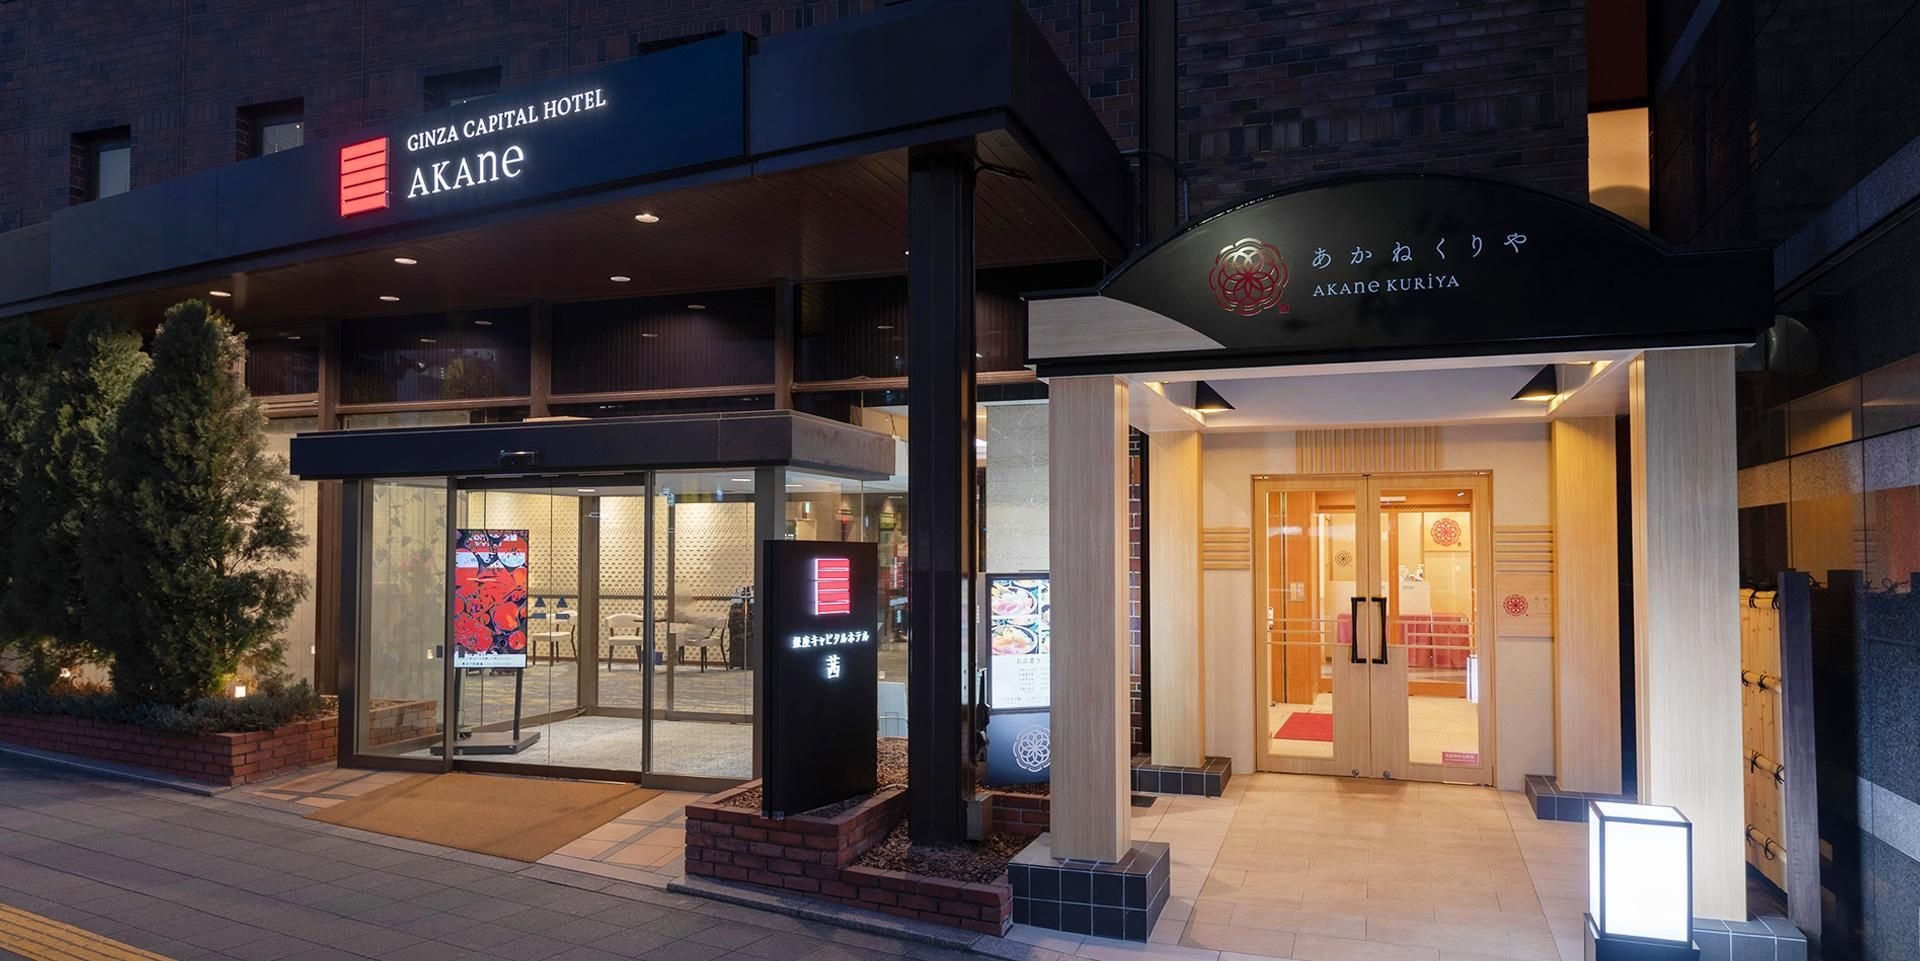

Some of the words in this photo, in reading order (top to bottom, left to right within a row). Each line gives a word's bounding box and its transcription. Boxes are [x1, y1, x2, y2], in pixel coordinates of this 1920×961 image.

[407, 125, 459, 151] GINZA
[463, 106, 539, 138] CAPITAL
[543, 88, 606, 119] HOTEL
[1312, 232, 1527, 269] あかねくりや
[825, 653, 841, 679] 茜
